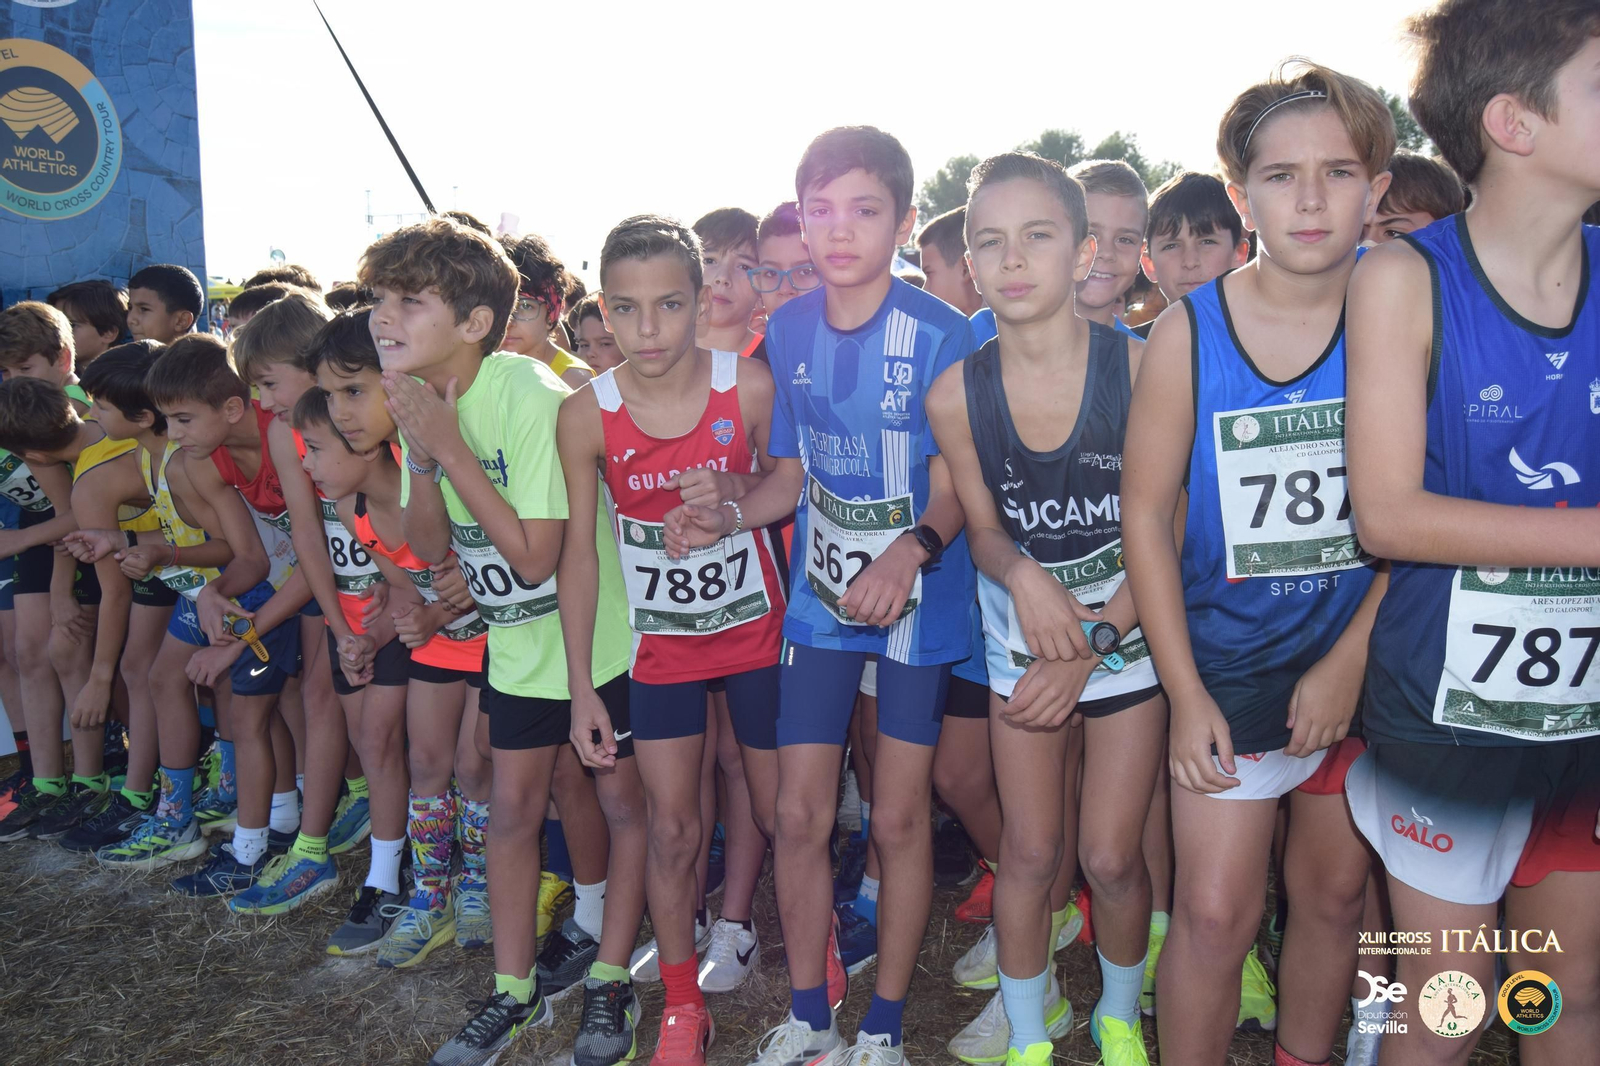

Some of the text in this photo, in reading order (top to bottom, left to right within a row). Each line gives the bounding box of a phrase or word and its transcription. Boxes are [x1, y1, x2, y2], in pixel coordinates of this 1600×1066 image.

[0, 48, 19, 60] EL
[6, 101, 114, 211] WORLD CROSS COUNTRY TOUR
[14, 145, 65, 161] WORLD
[3, 158, 77, 176] ATHLETICS
[1273, 408, 1345, 433] ITÁLIC
[1463, 404, 1523, 419] PIRAL
[1268, 440, 1344, 453] ALEJANDRO SANC
[1307, 448, 1344, 457] GALOSPOR
[823, 494, 878, 522] ITÁLICA
[635, 547, 749, 605] 7887
[1270, 565, 1303, 574] FEDERACIÓN
[1270, 575, 1341, 596] SPORT
[1555, 597, 1582, 605] LOPEZ
[1391, 814, 1453, 853] GALO
[284, 867, 319, 898] HOKA
